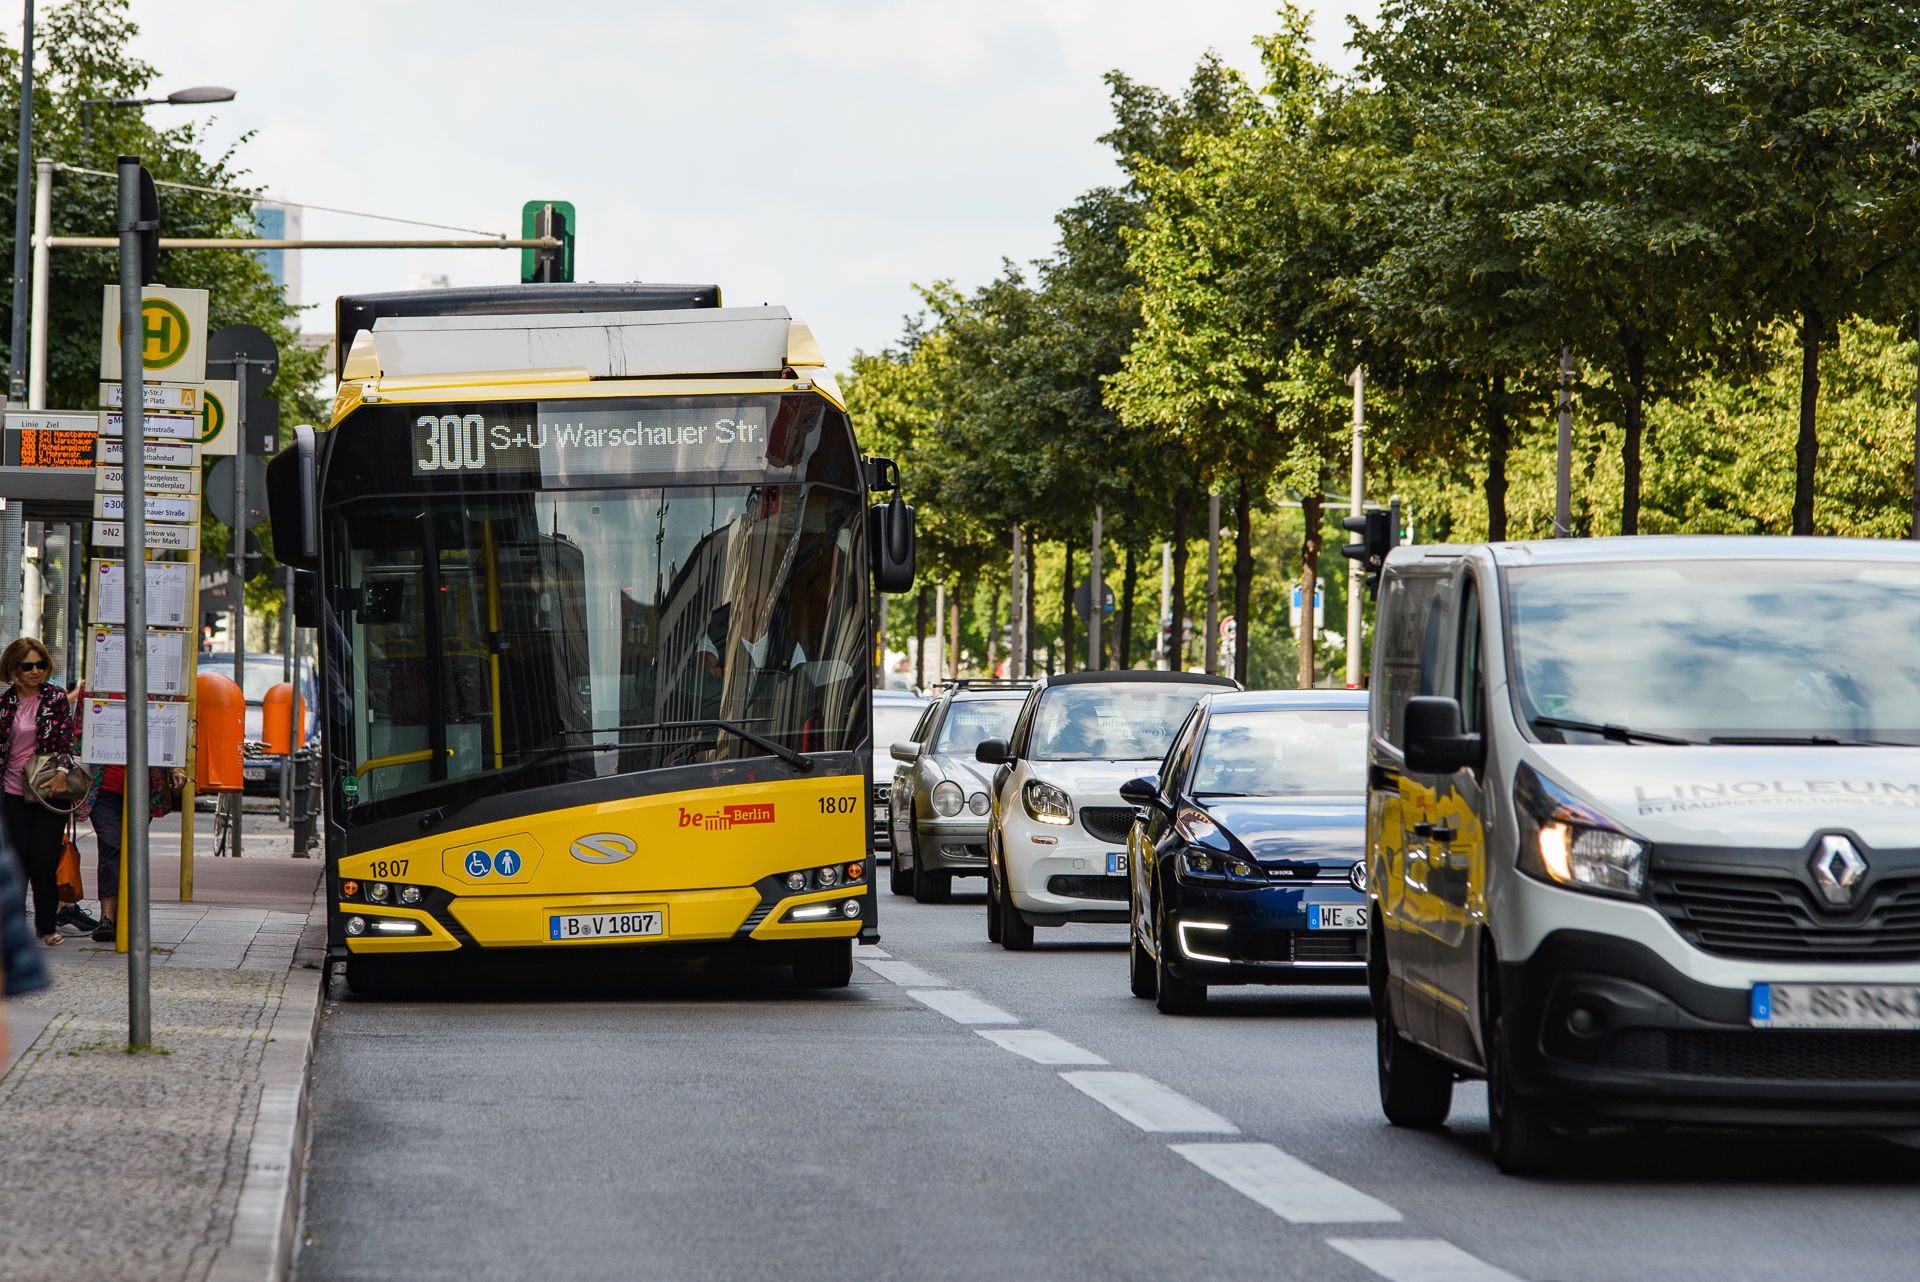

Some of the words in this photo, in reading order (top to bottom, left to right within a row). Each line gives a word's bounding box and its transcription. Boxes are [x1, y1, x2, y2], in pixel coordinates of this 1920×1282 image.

[149, 397, 165, 405] Platz
[182, 391, 195, 406] A
[21, 420, 39, 428] Linie
[416, 414, 485, 470] 300
[490, 425, 547, 449] S+U
[554, 421, 708, 448] Warschauer
[714, 418, 764, 444] Str.
[165, 509, 186, 517] Straße
[107, 528, 120, 537] N2
[162, 537, 181, 545] Markt
[818, 796, 857, 814] 1807
[678, 807, 704, 827] be
[733, 808, 771, 822] Berlin
[369, 859, 409, 878] 1807
[568, 918, 580, 936] B
[592, 917, 604, 935] V
[608, 914, 654, 934] 1807
